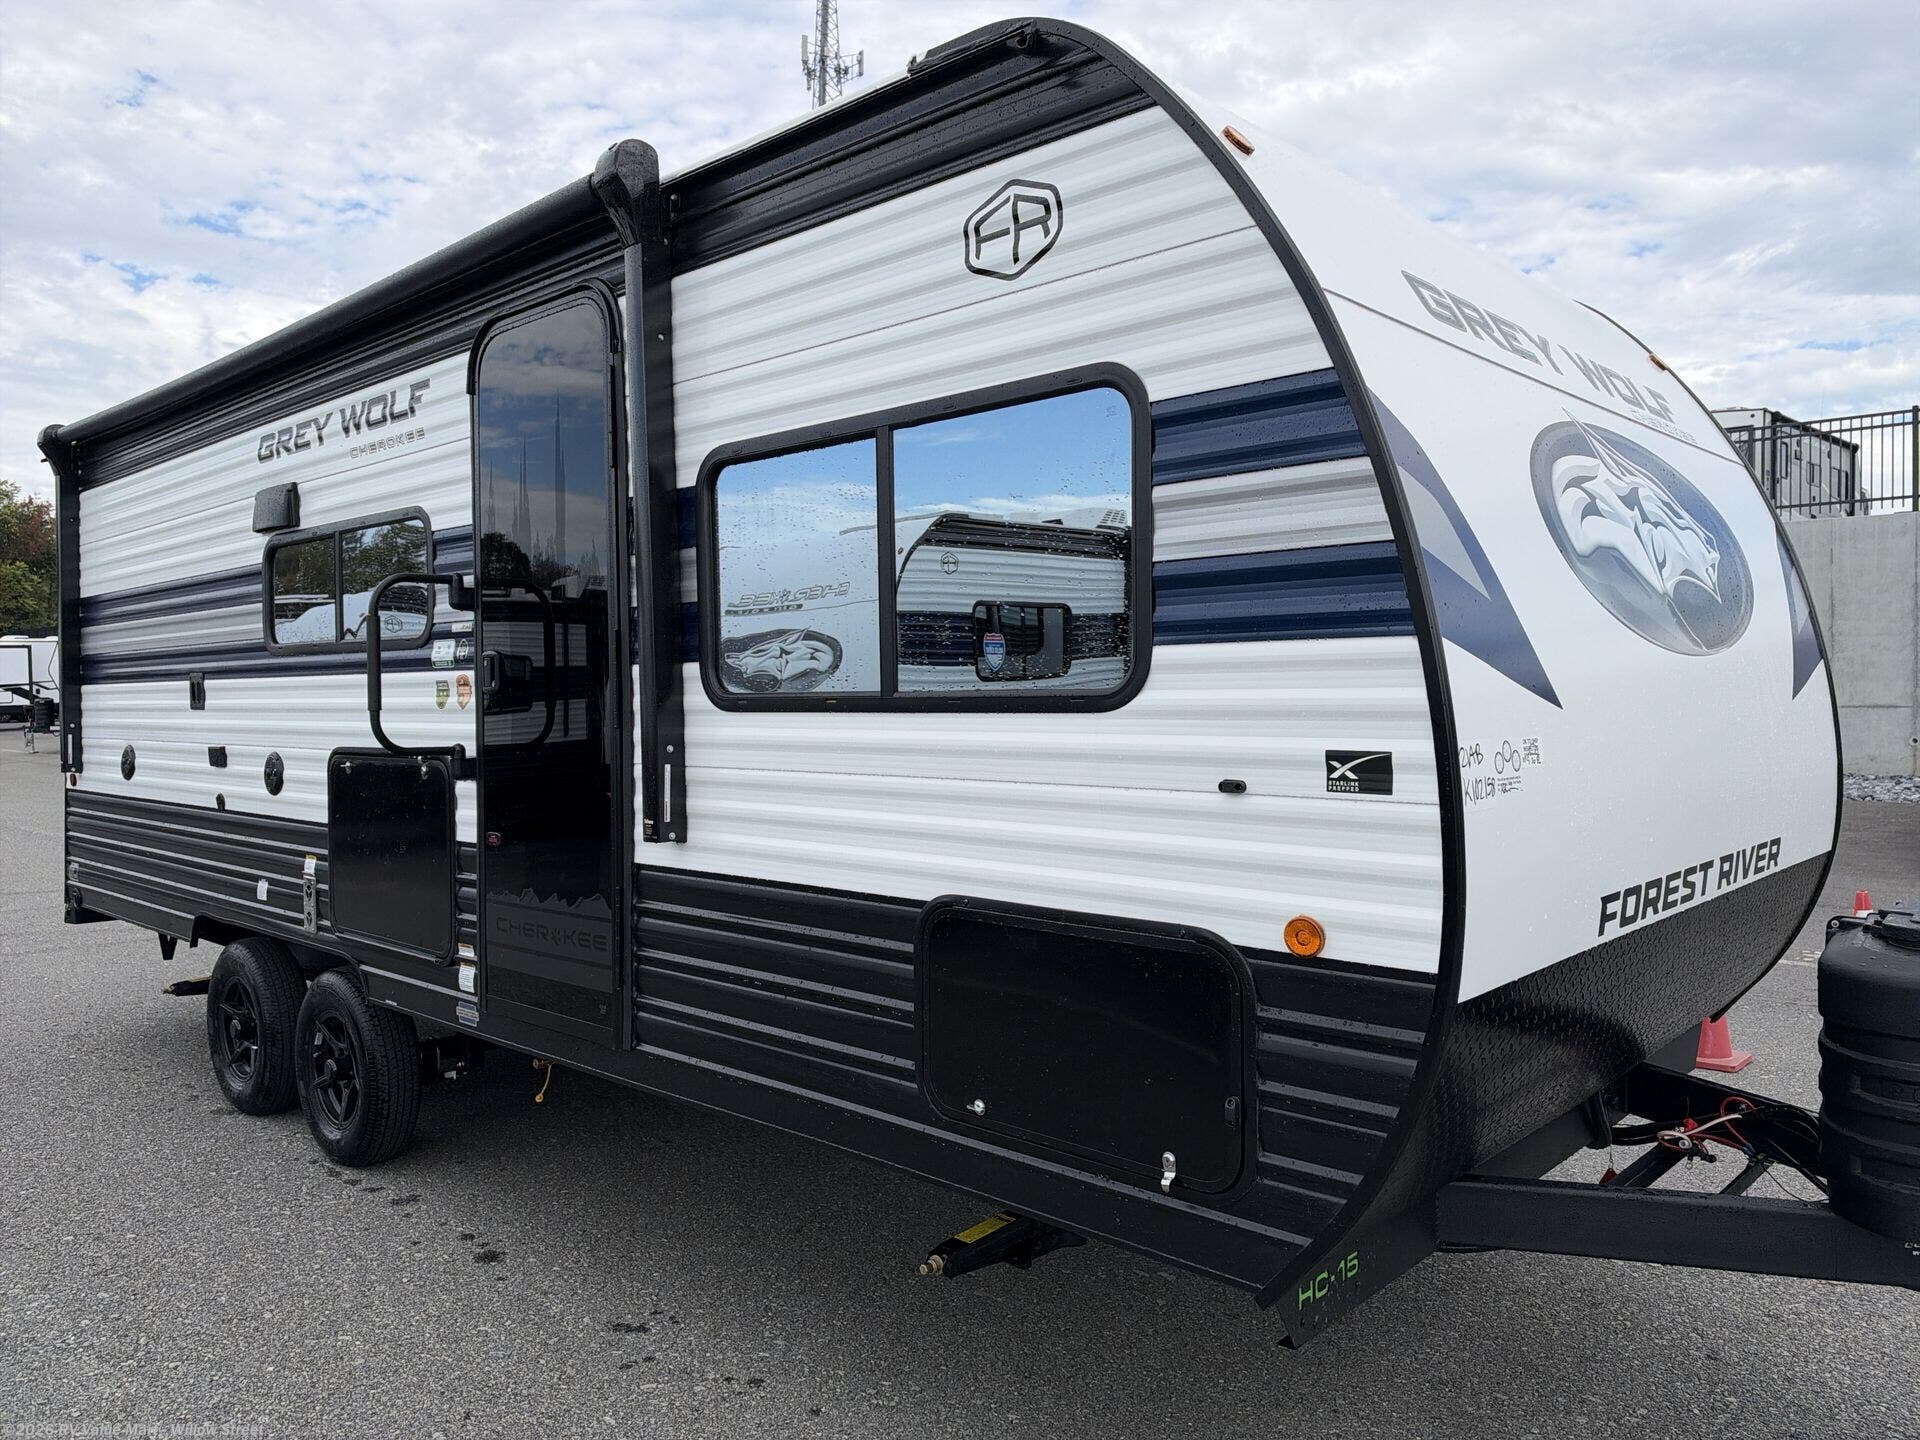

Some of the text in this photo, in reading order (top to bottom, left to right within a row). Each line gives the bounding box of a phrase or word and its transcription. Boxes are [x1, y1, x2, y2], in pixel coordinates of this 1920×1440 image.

[1401, 269, 1676, 425] GREY WOLF
[257, 378, 431, 465] GREY WOLF
[351, 426, 426, 460] CHEROKEE
[1598, 837, 1782, 938] FOREST RIVER
